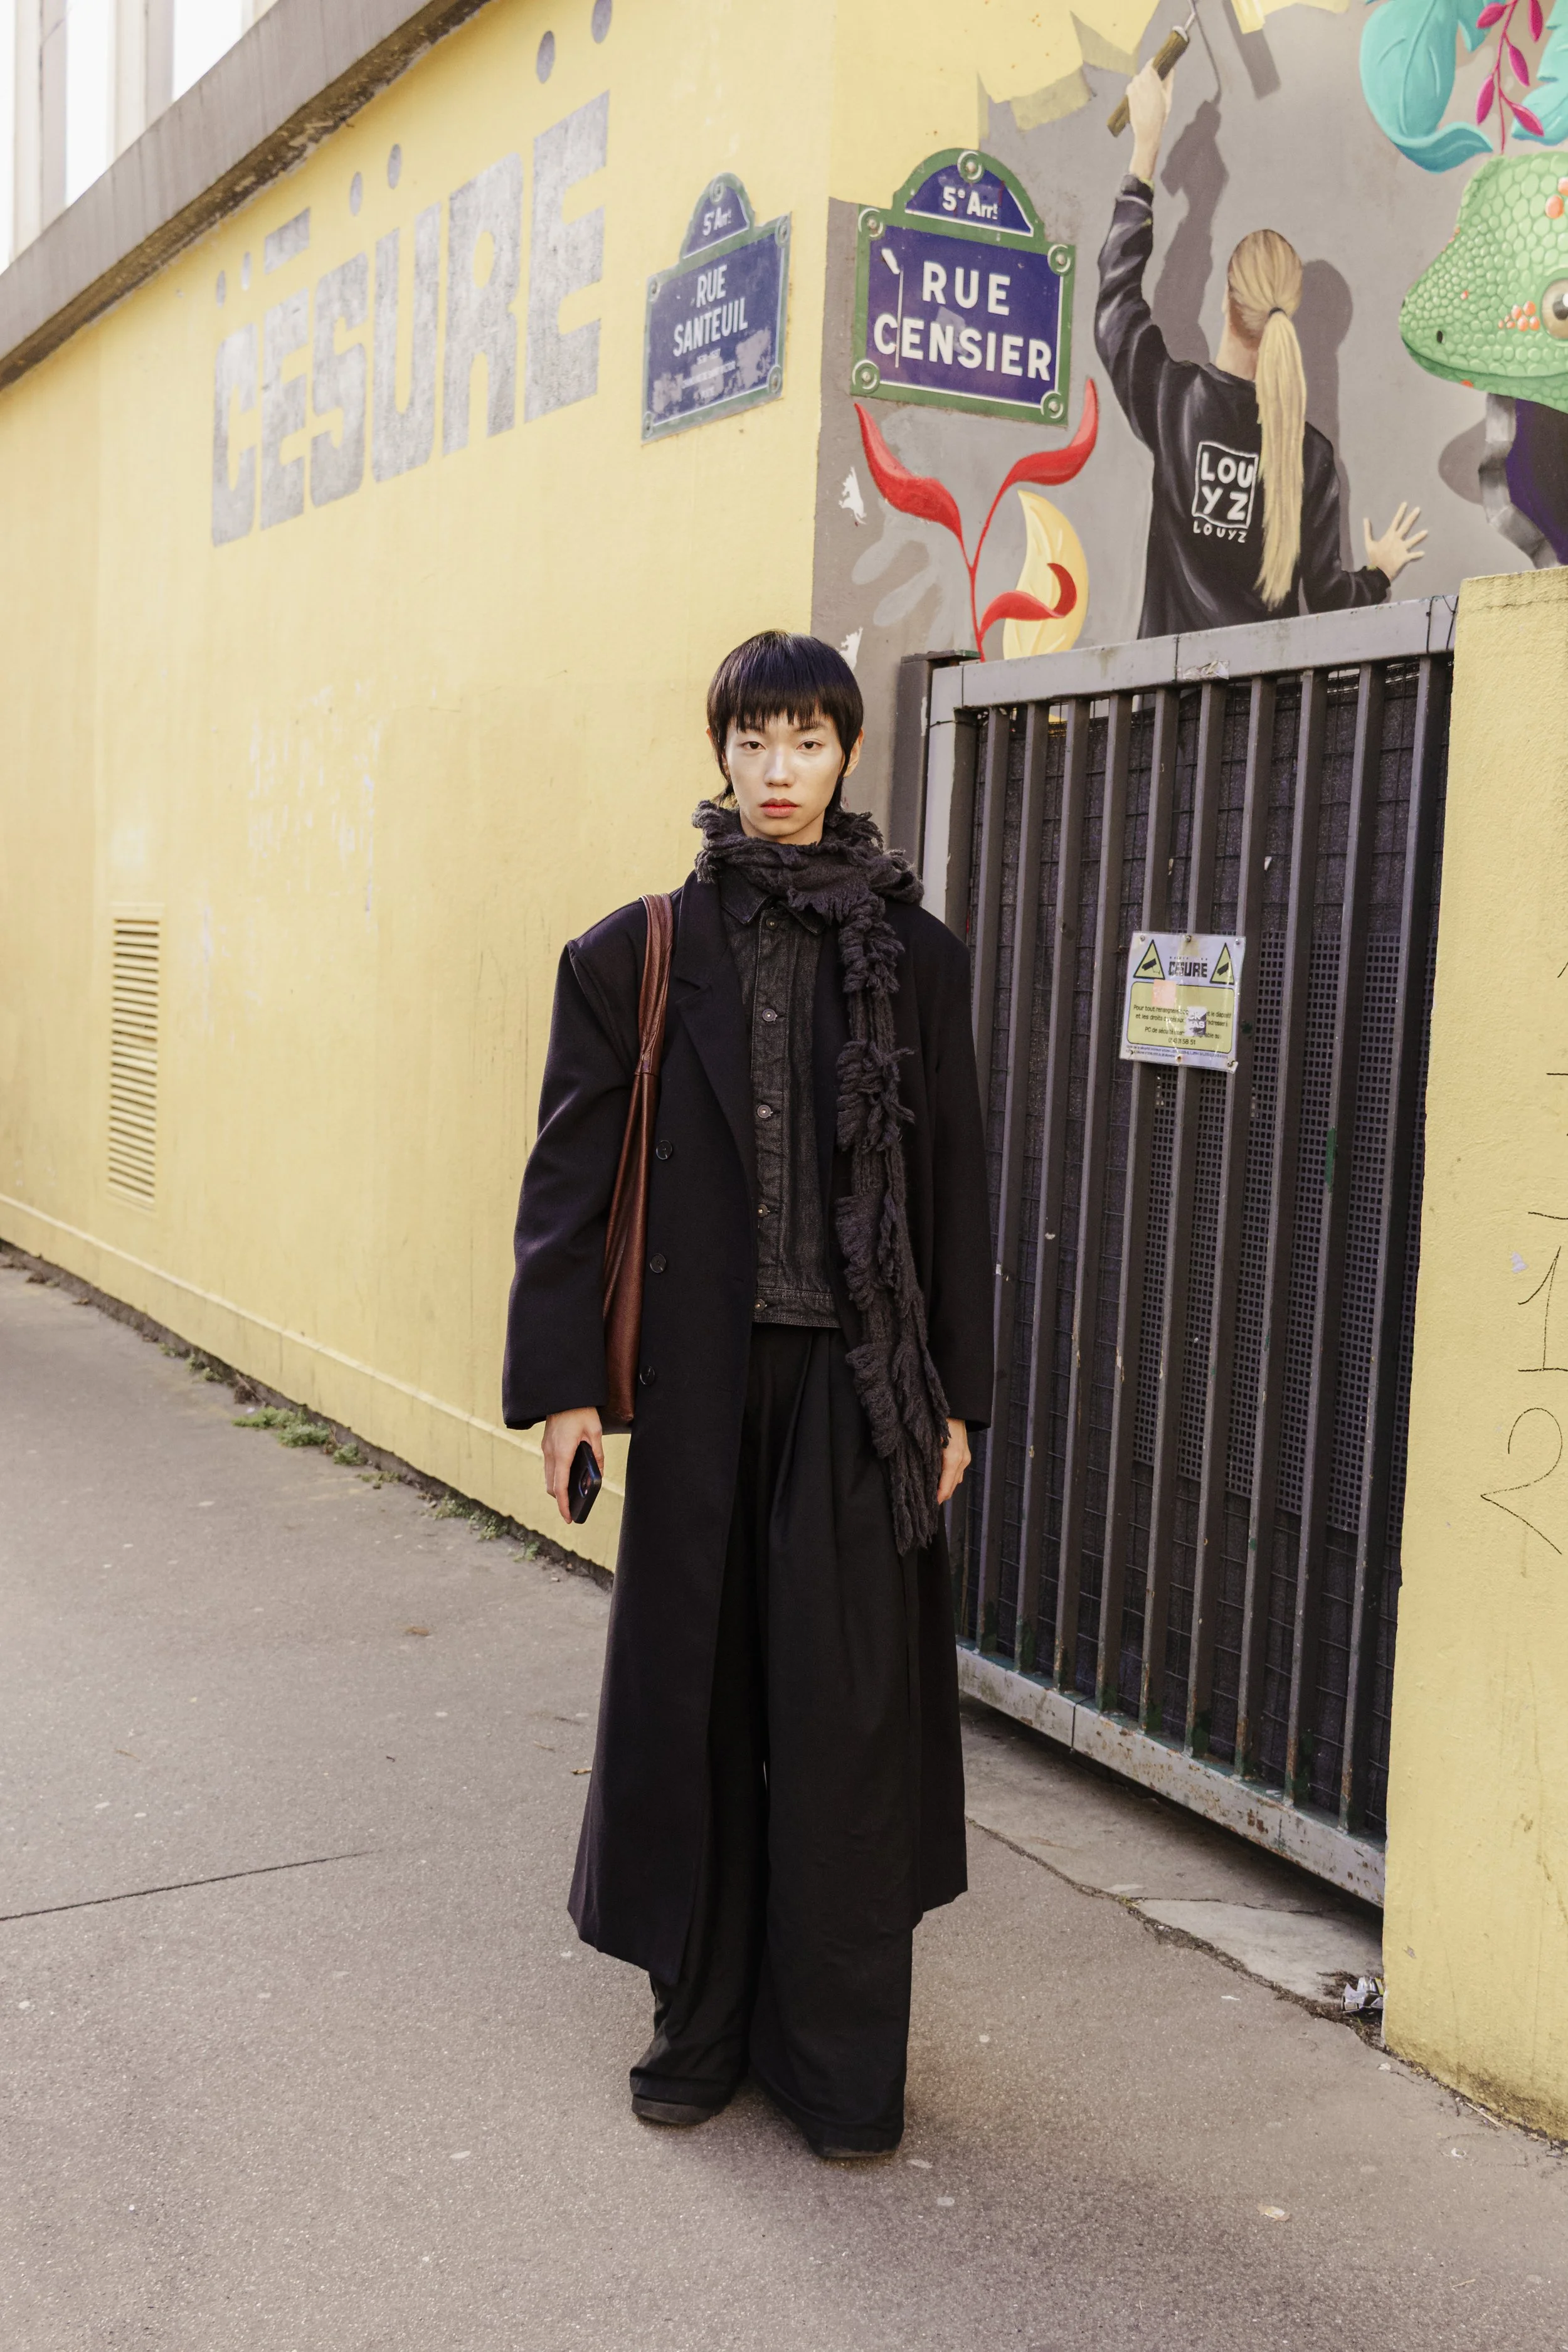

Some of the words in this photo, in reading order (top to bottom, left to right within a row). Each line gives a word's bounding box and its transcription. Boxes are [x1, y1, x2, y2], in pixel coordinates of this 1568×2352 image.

[942, 186, 966, 211] 5e
[966, 191, 999, 220] Arrt
[696, 264, 728, 308] RUE
[922, 261, 1011, 316] RUE
[673, 297, 748, 357] SANTEUIL
[873, 313, 1052, 381] CENSIER
[1200, 451, 1254, 488] LOU
[1193, 520, 1248, 543] LOUYZ
